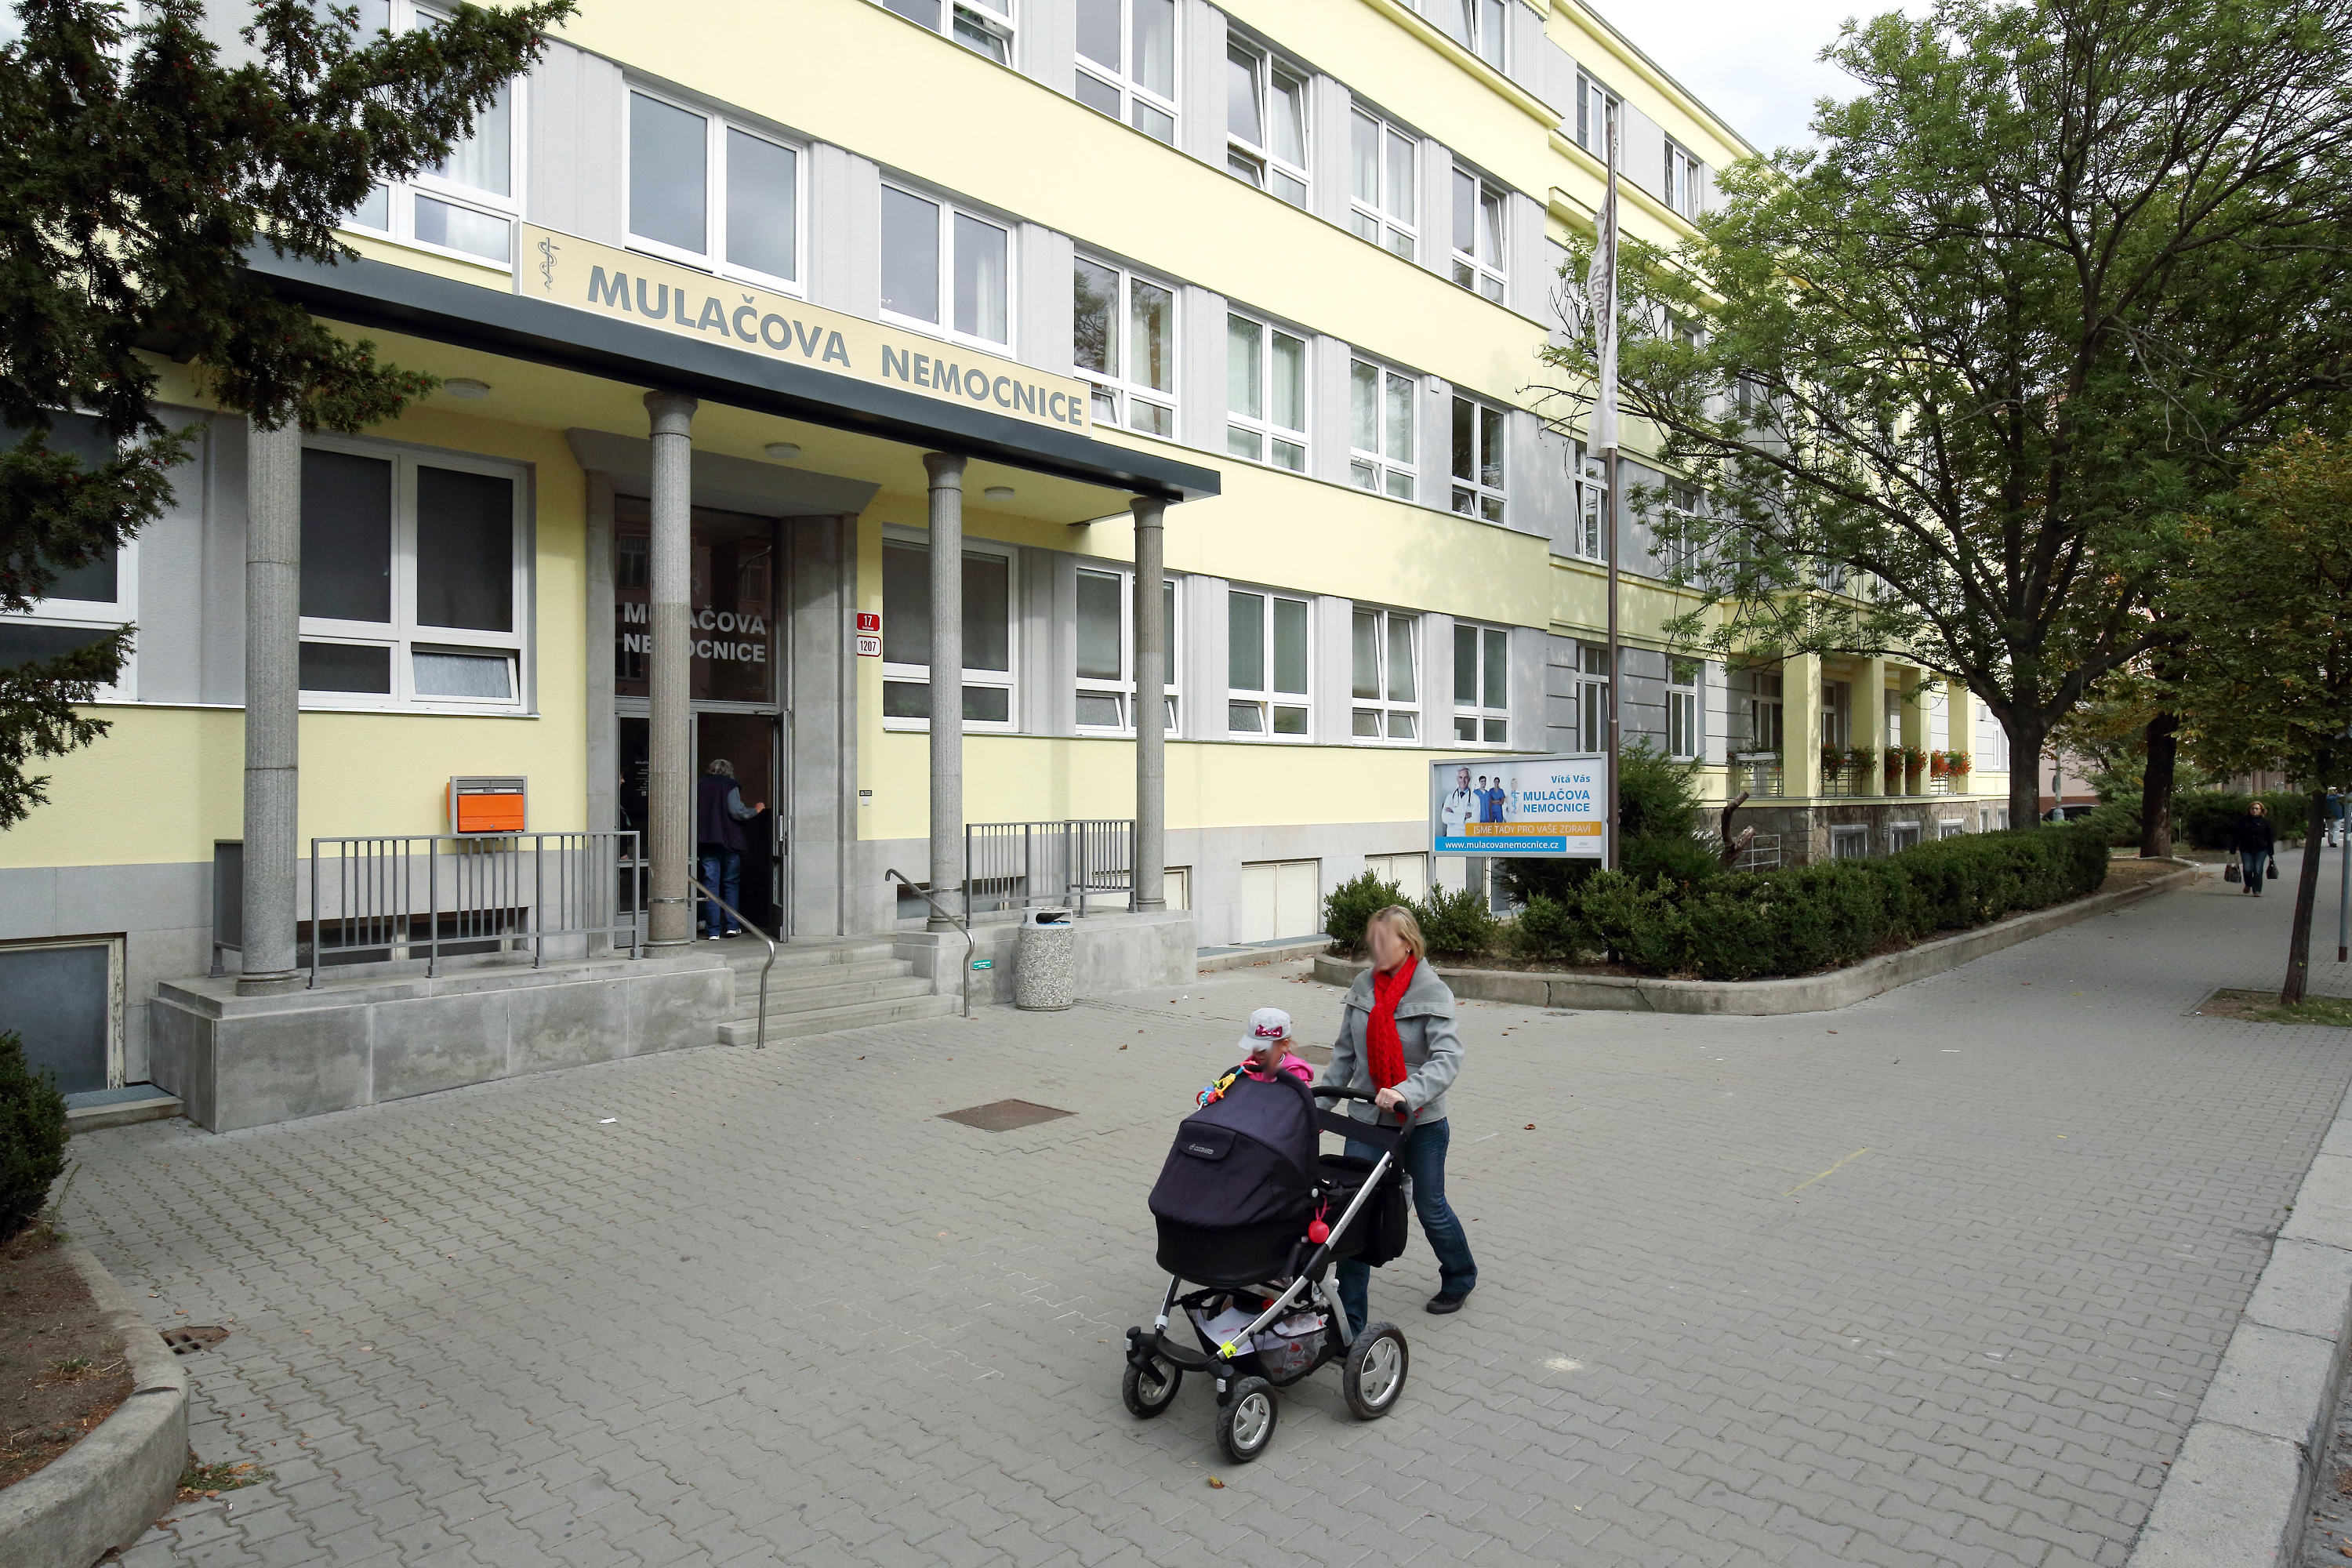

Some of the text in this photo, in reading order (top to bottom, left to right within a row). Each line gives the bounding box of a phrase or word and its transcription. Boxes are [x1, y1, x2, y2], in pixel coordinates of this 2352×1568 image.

[586, 265, 1083, 426] MULAČOVA NEMOCNICE
[624, 601, 767, 635] MČOVA
[863, 615, 873, 626] 17
[623, 633, 766, 662] NECNICE
[860, 640, 877, 652] 1207
[1552, 774, 1591, 784] Vítá Vás
[1523, 788, 1590, 801] MULAČOVA
[1523, 803, 1590, 813] NEMOCNICE
[1472, 822, 1591, 836] JSME TADY PRO VAŠE ZDRAVÍ
[1445, 840, 1559, 850] www.mulacovanemocnice.cz
